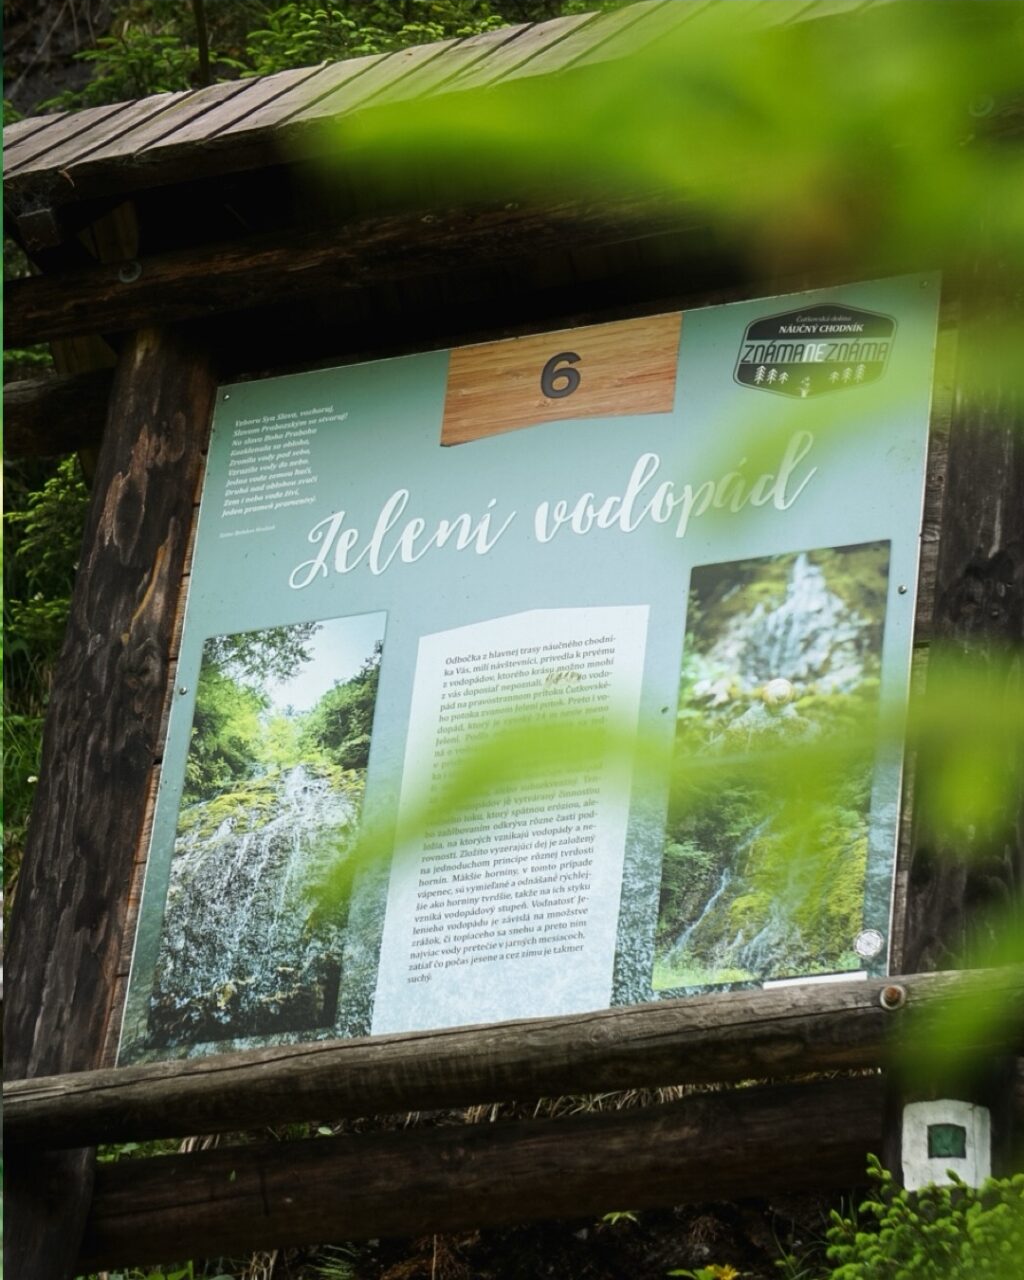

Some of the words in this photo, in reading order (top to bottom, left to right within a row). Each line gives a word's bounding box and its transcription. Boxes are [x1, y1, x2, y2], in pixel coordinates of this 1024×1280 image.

[779, 323, 820, 334] NÁUČNÝ
[819, 323, 864, 333] CHODNÍK
[541, 352, 581, 398] 6
[289, 489, 516, 589] Jelení
[534, 430, 817, 543] vodopád
